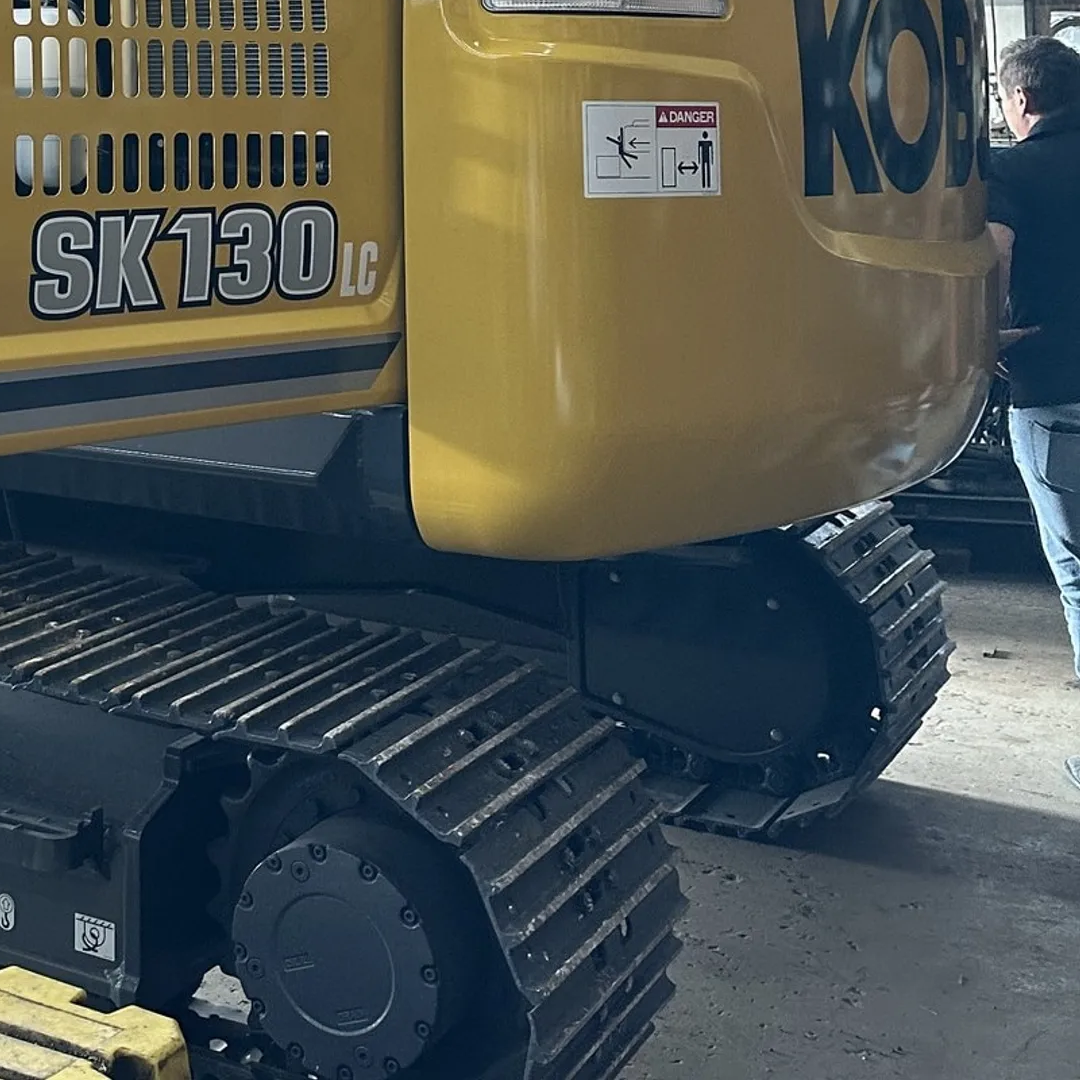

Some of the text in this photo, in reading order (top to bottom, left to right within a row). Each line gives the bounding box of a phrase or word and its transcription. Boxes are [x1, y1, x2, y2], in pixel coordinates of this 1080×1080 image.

[669, 110, 714, 123] DANGER
[29, 199, 379, 321] SK130 LC
